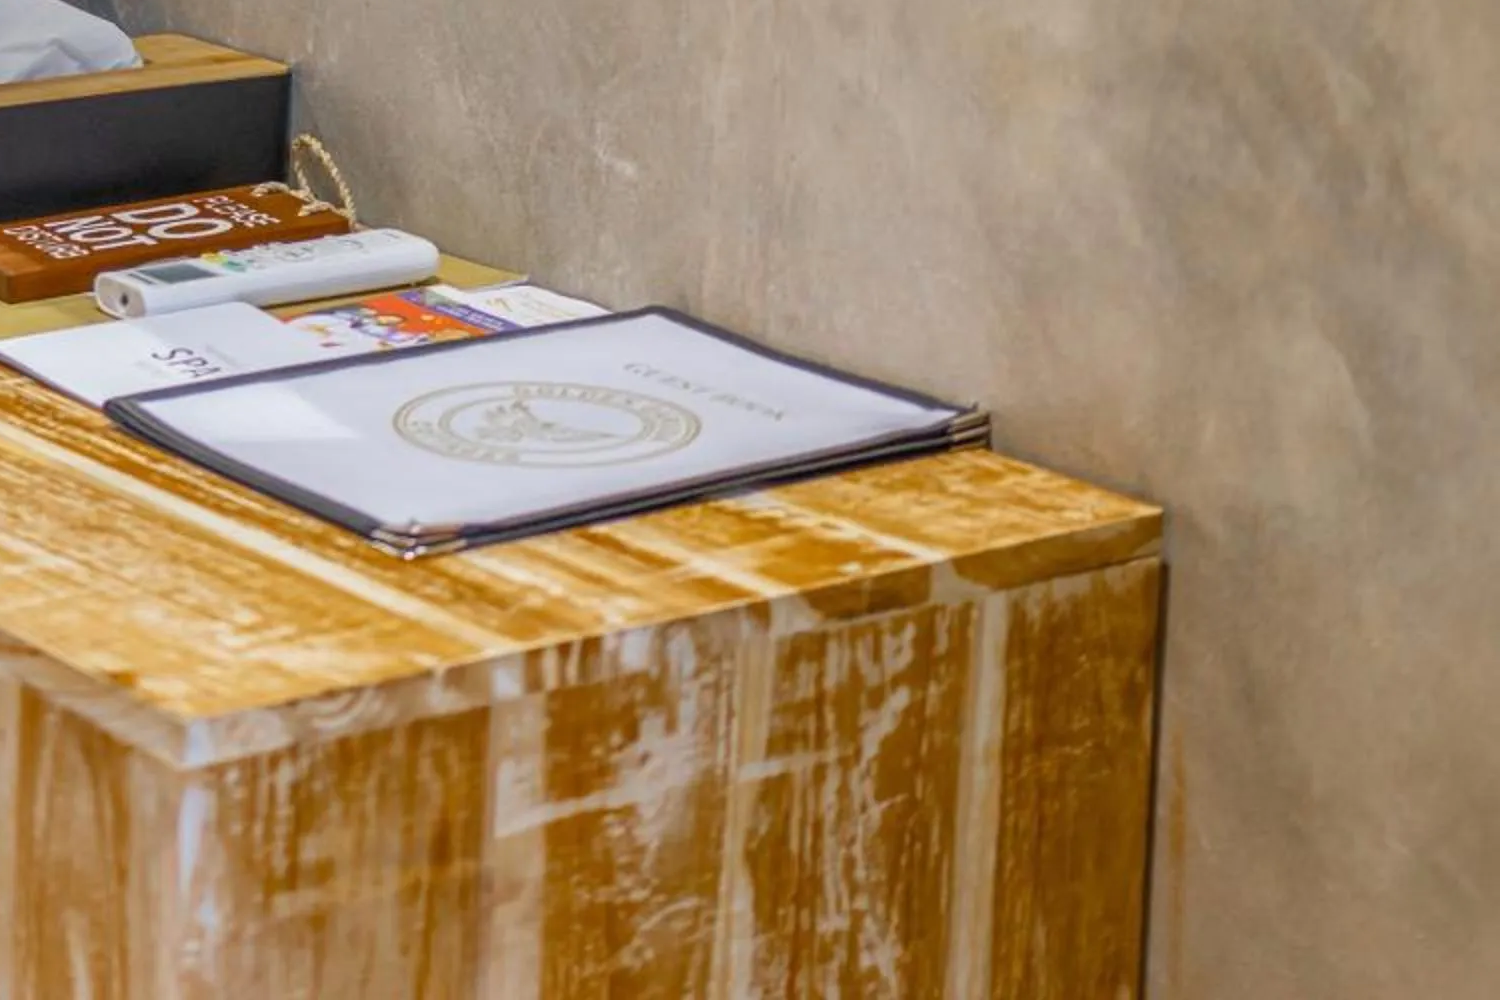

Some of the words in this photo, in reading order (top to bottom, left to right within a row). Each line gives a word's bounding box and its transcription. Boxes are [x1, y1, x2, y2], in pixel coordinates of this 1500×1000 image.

[43, 215, 159, 252] NOT
[110, 203, 233, 240] DO
[151, 346, 221, 378] SPA
